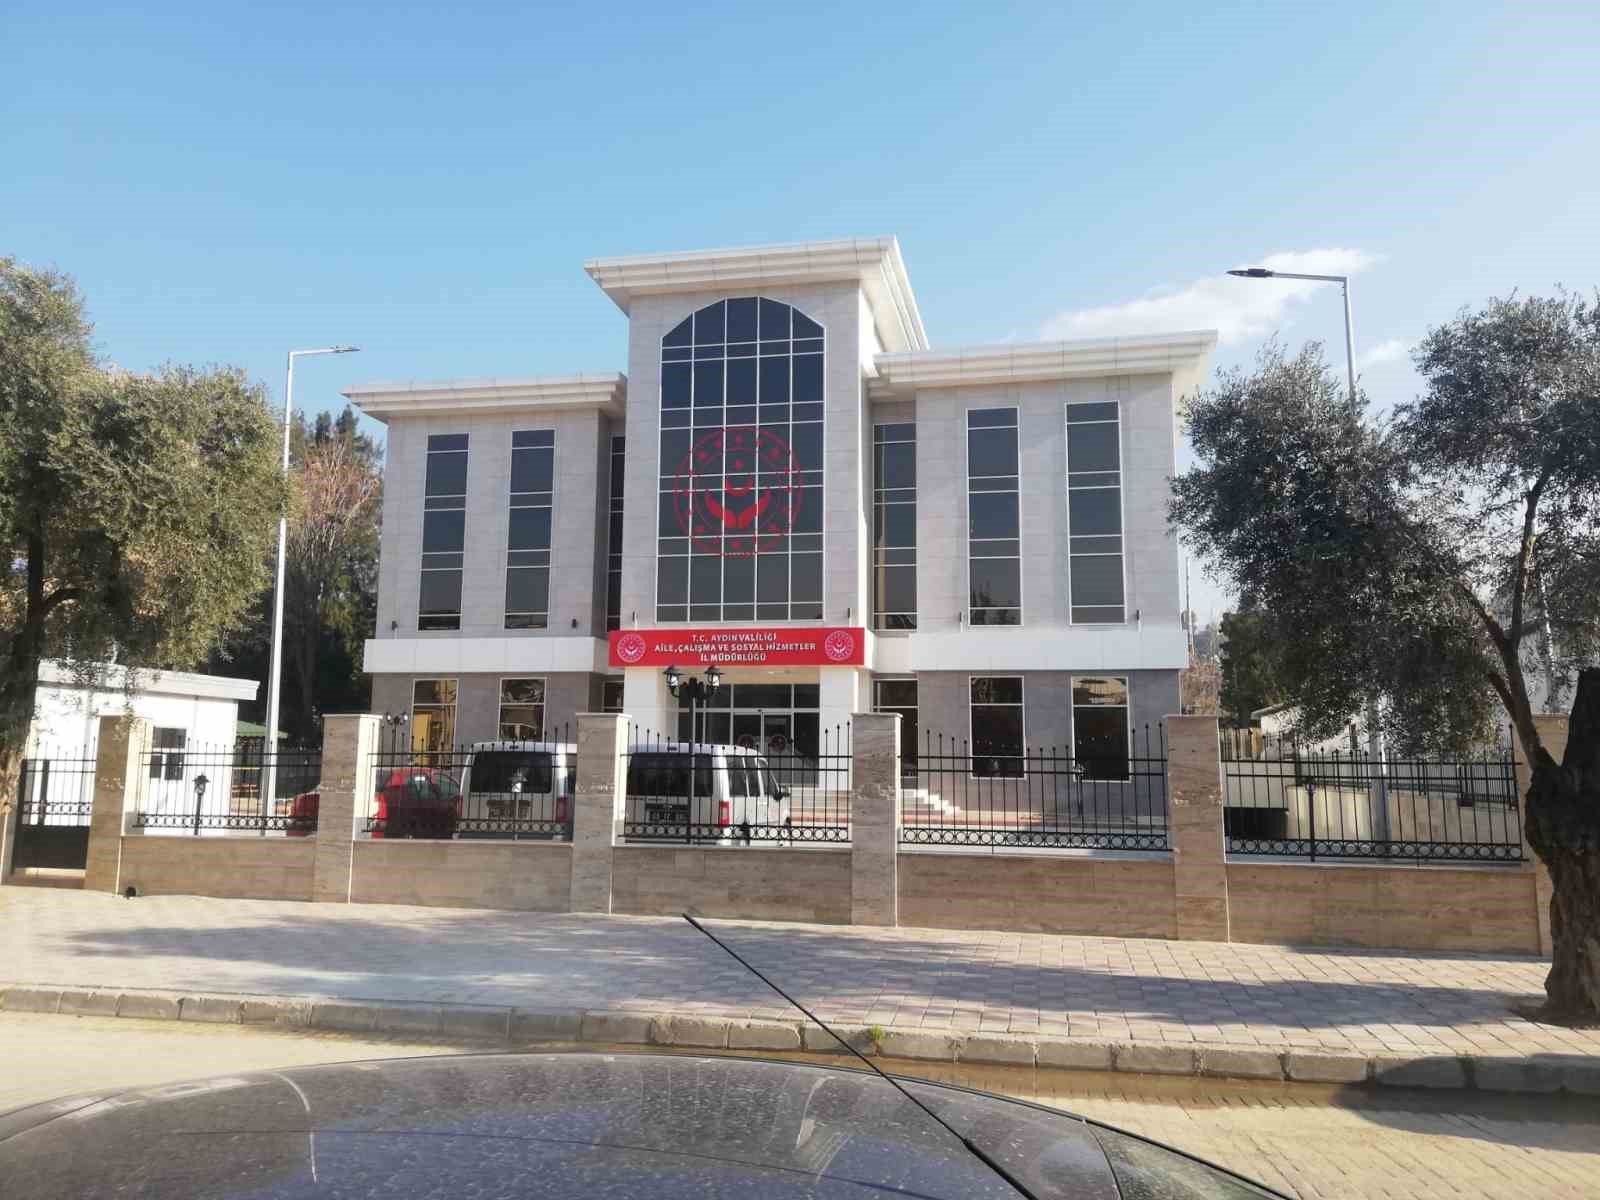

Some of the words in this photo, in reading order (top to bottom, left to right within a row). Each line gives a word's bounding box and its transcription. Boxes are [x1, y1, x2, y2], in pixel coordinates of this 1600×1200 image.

[692, 634, 708, 643] T.C.
[711, 634, 738, 642] AYDIN
[718, 643, 730, 652] VE
[731, 643, 765, 652] SOSYAL
